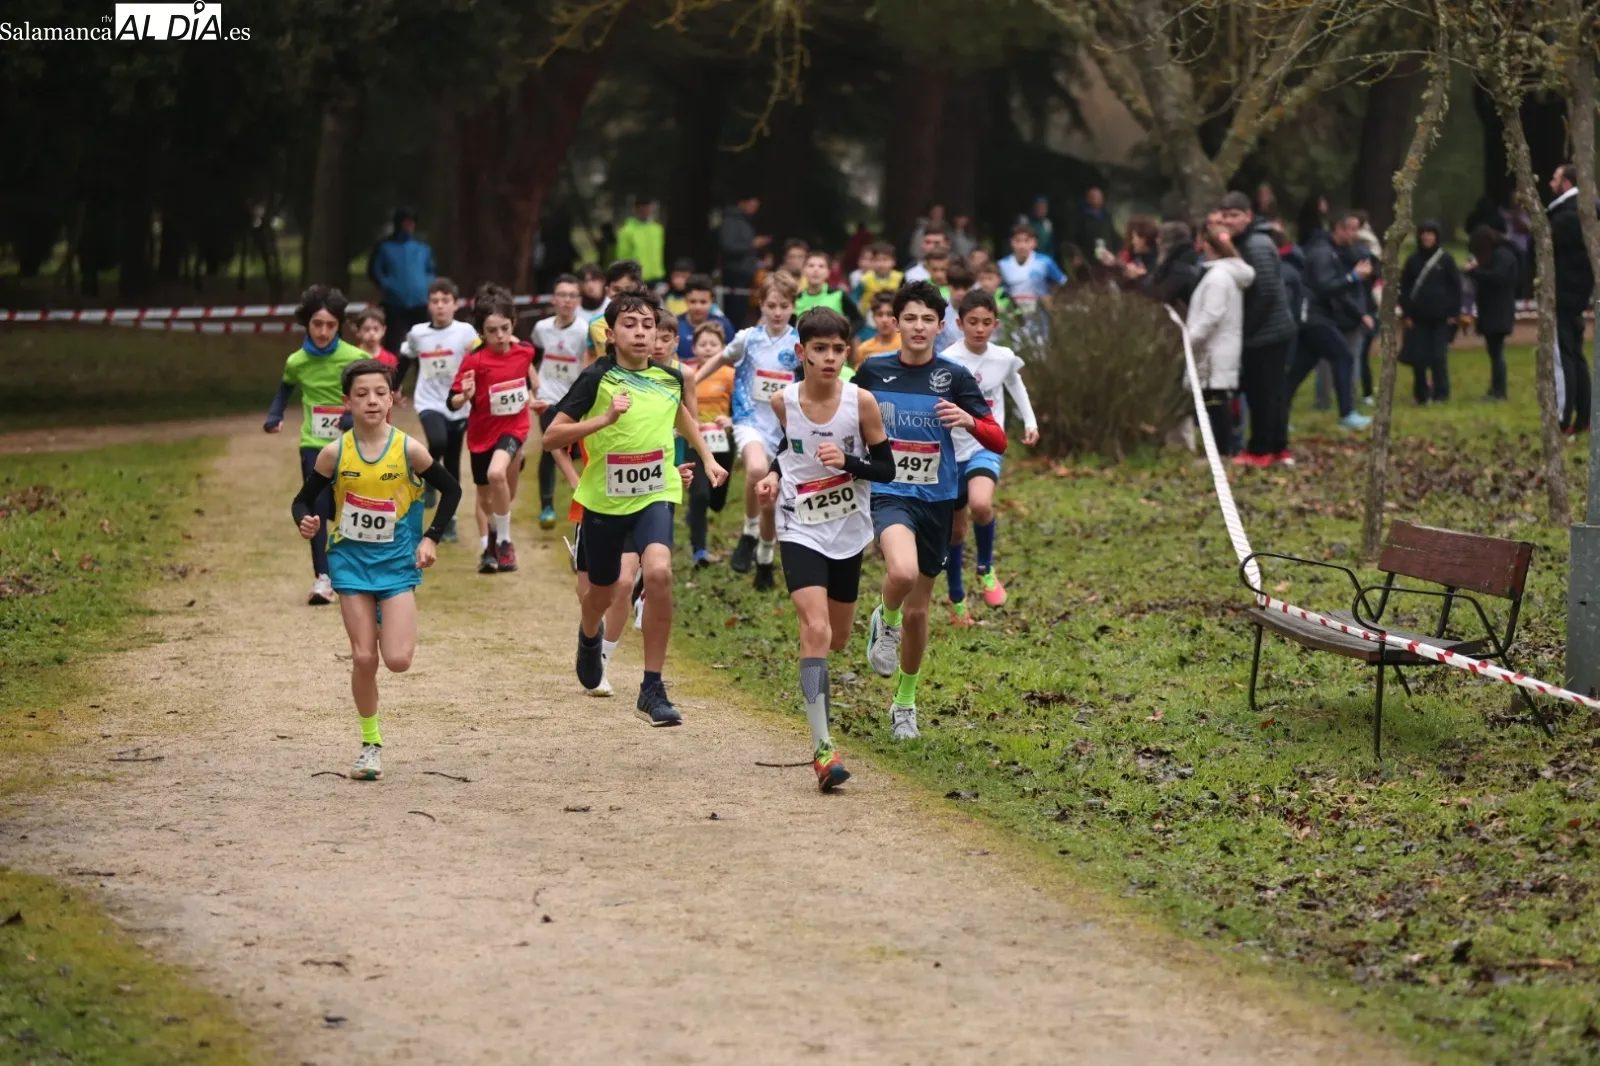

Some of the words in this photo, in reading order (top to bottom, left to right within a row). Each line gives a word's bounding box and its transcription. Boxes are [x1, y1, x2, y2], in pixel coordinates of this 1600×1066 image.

[431, 359, 446, 369] 12
[499, 391, 525, 405] 518
[897, 455, 933, 472] 497
[613, 464, 663, 483] 1004
[803, 487, 854, 511] 1250
[350, 512, 386, 530] 190
